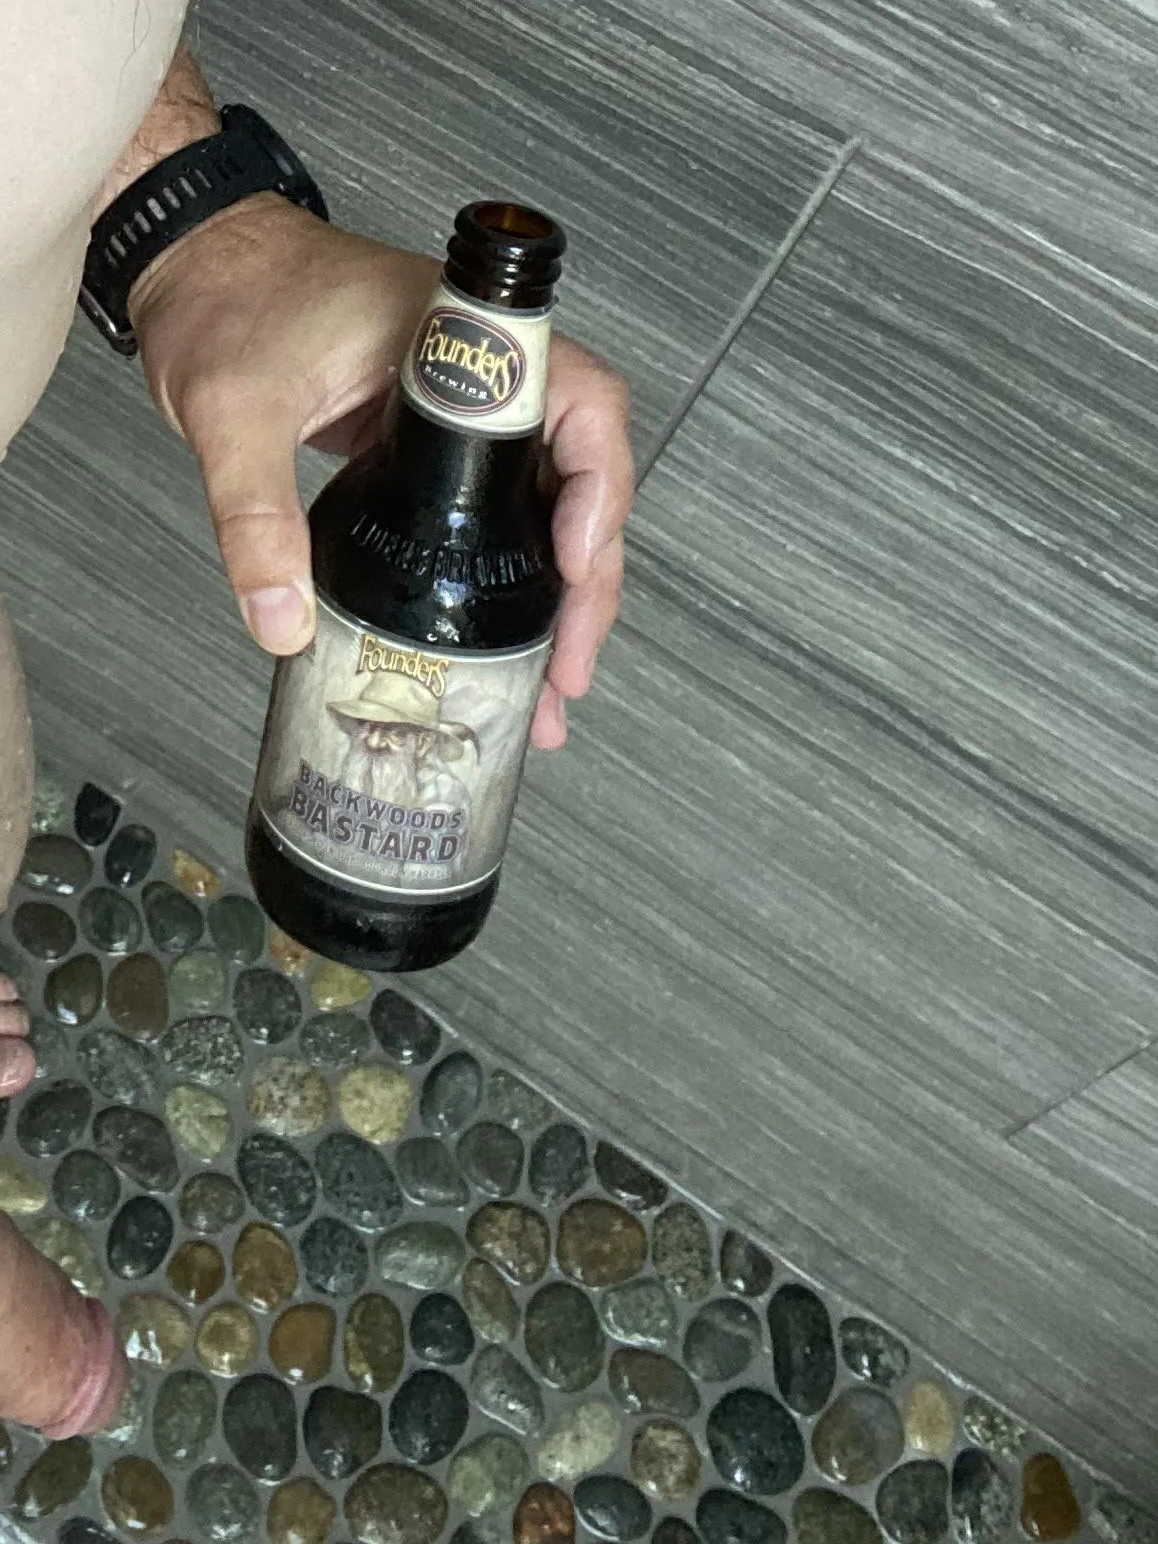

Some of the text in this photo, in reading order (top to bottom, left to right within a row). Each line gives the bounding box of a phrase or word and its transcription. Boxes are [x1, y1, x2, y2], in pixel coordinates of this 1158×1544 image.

[419, 318, 519, 401] Founders
[357, 634, 450, 697] Founders
[292, 784, 460, 862] BASTARD
[299, 762, 462, 830] BACKWOODS
